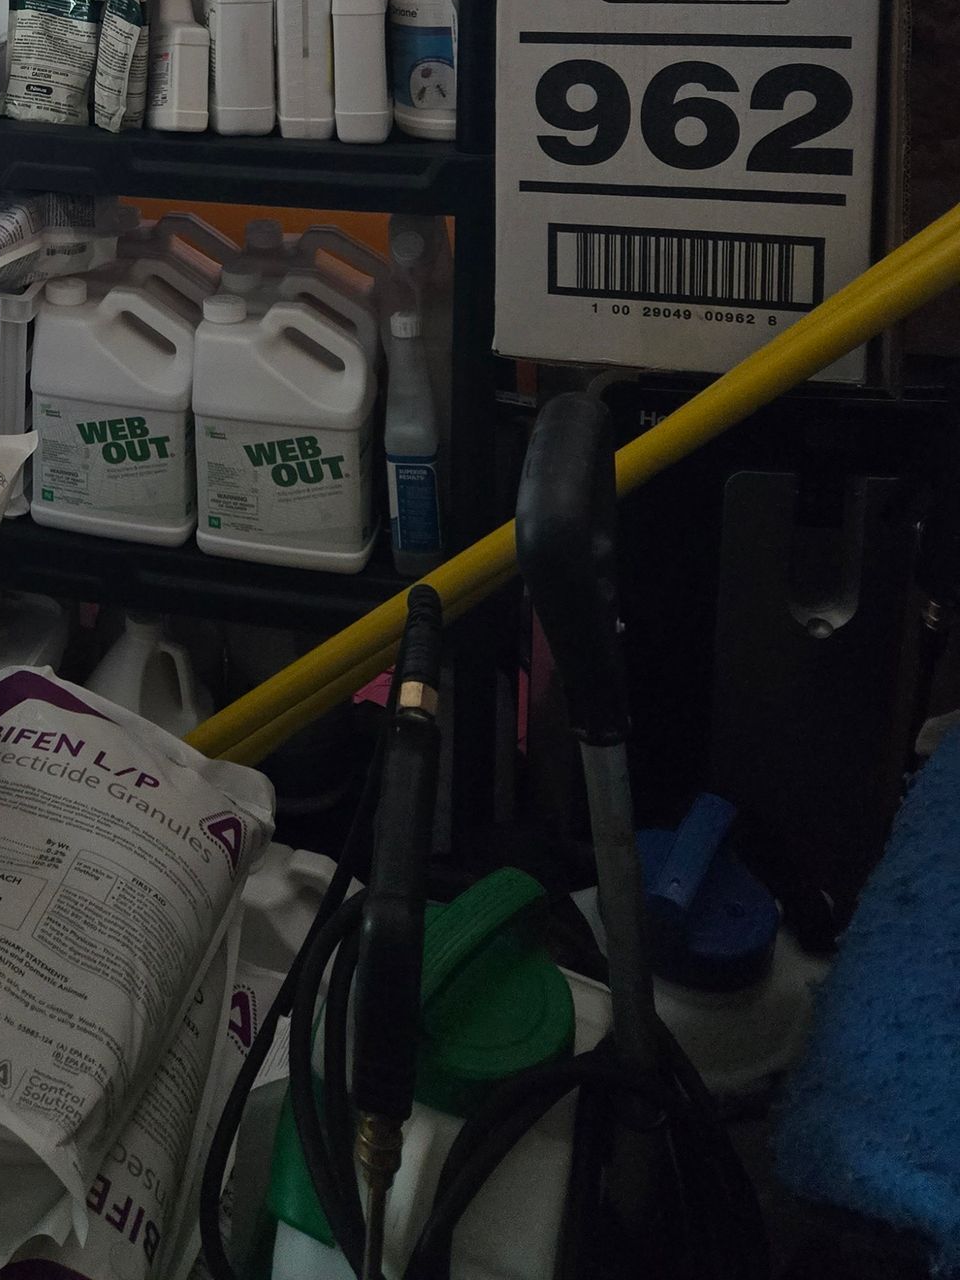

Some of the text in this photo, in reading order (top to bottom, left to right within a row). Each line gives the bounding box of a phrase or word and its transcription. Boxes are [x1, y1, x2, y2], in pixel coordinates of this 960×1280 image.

[534, 58, 854, 176] 962
[592, 303, 777, 326] 1 00 29049 00962 8
[76, 417, 149, 445] WEB
[102, 436, 170, 464] OUT
[243, 436, 322, 467] WEB
[271, 456, 345, 487] OUT
[93, 750, 160, 789] L/P
[107, 782, 212, 864] Granules
[132, 877, 166, 906] FIRST AID
[6, 950, 21, 964] and
[24, 959, 56, 986] Domestic
[57, 983, 88, 1000] Animals
[25, 951, 69, 983] STATEMENTS
[69, 1047, 84, 1059] EPA
[28, 1075, 86, 1107] Control
